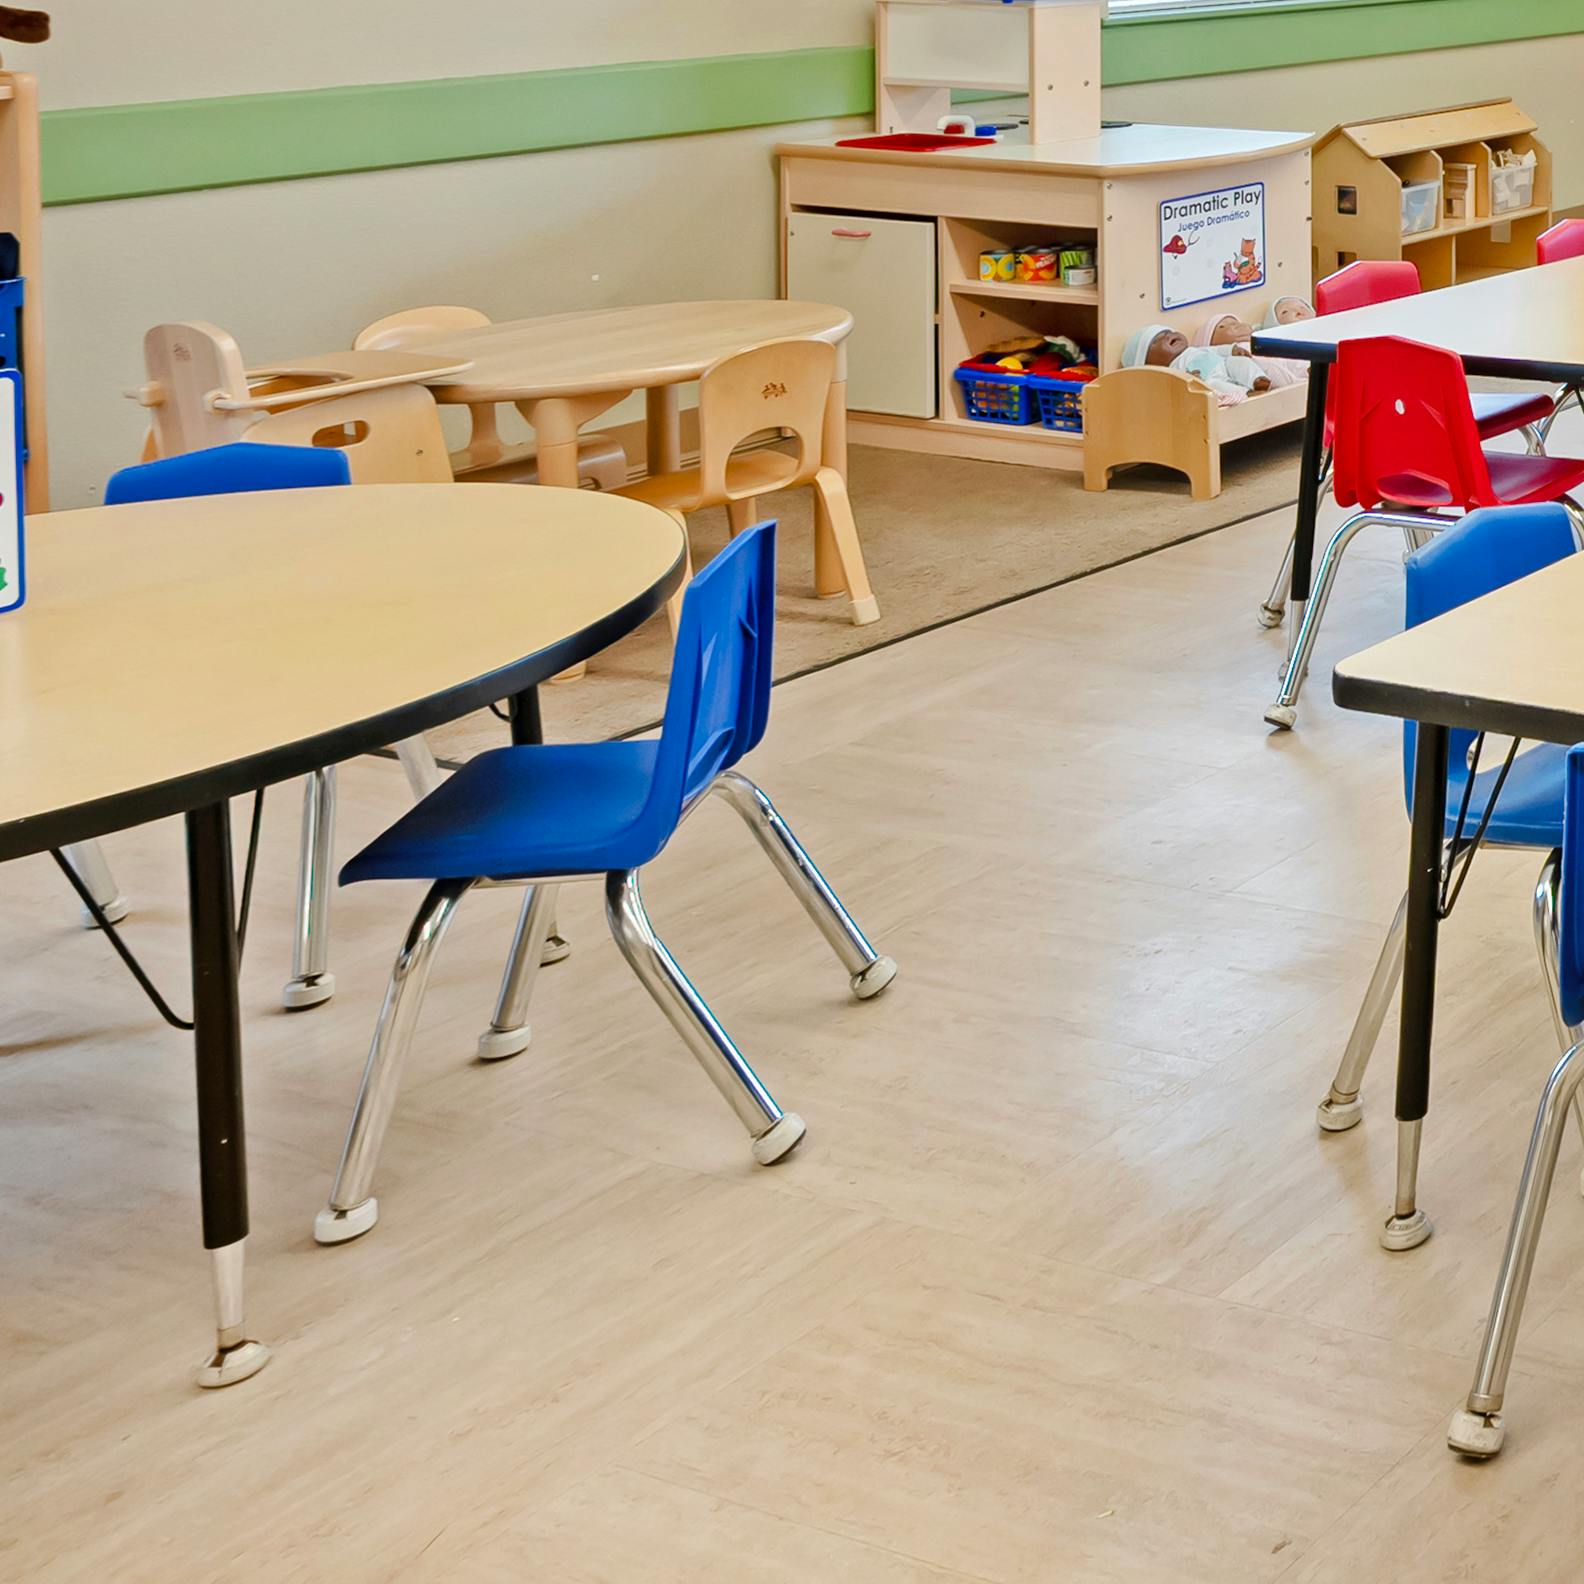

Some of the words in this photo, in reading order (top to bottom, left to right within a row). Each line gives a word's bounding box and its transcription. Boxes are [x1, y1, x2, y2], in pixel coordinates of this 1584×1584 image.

[1163, 195, 1229, 221] Dramatic
[1233, 190, 1261, 206] Play
[1178, 220, 1205, 233] Juego
[1207, 209, 1250, 226] Dramático
